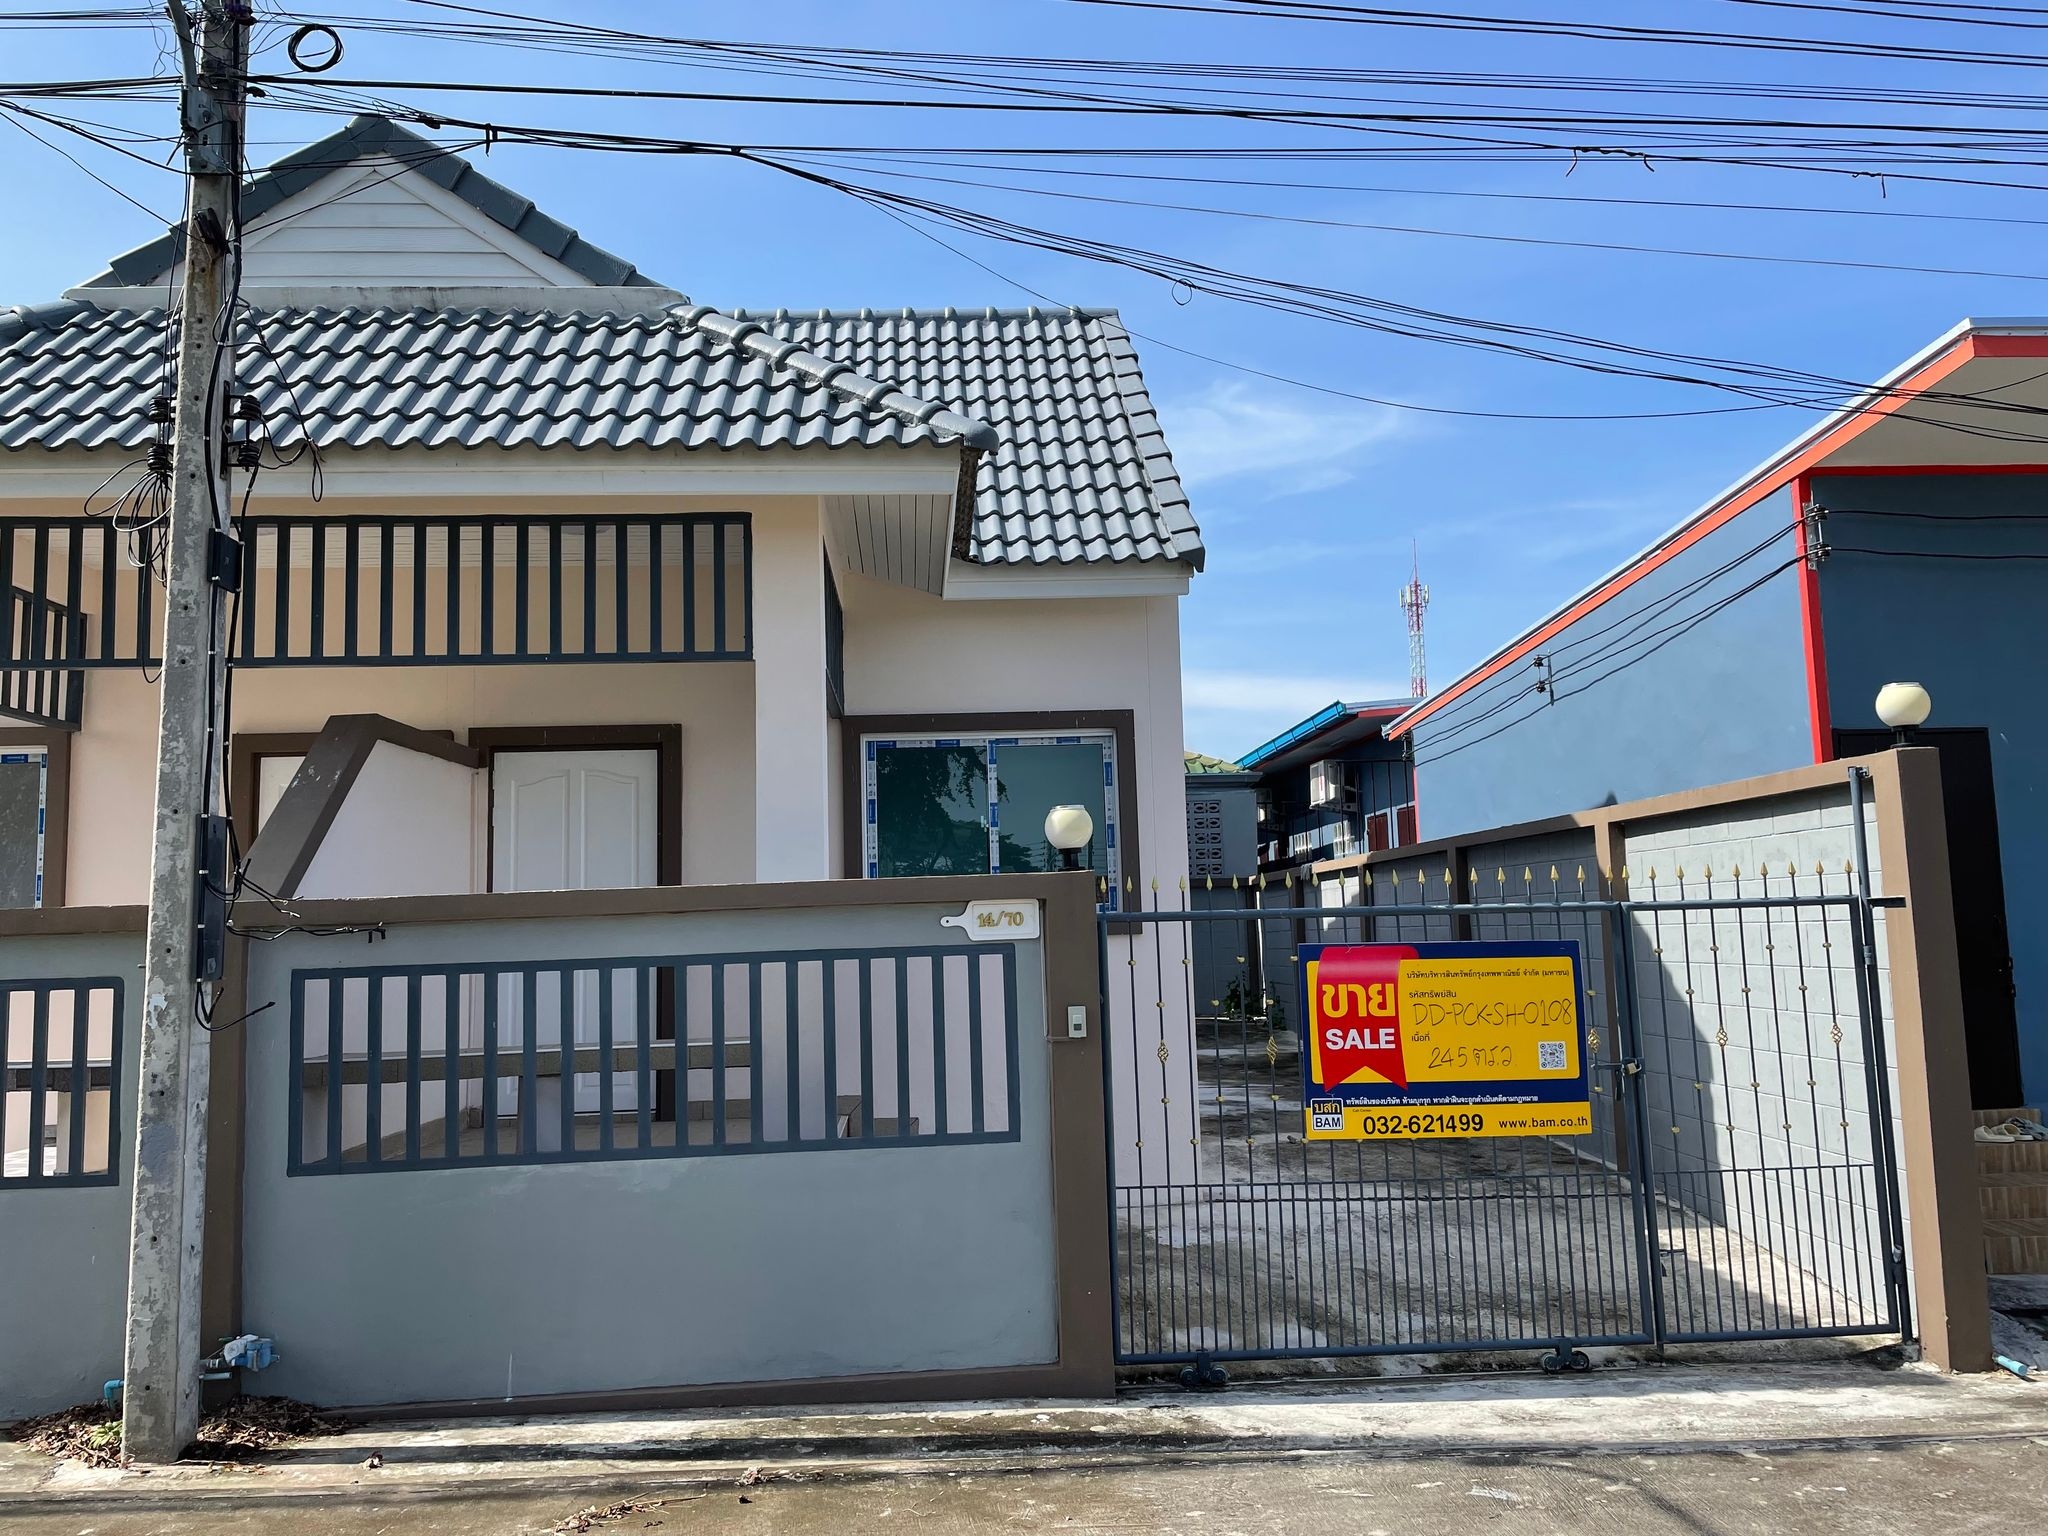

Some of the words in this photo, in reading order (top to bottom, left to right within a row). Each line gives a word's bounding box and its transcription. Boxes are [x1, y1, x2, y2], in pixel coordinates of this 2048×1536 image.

[976, 911, 1025, 928] 14/70
[1523, 969, 1540, 977] จำกัด
[1542, 969, 1570, 977] (มหาชน)
[1409, 989, 1457, 998] รหัสทรัพย์สิน
[1322, 983, 1396, 1018] ขาย
[1325, 1028, 1396, 1050] SALE
[1411, 1031, 1430, 1042] เนื้อที่
[1314, 1103, 1340, 1113] บสก
[1315, 1117, 1341, 1128] BAM
[1363, 1113, 1484, 1135] 032-621499
[1498, 1116, 1588, 1129] www.bam.co.th
